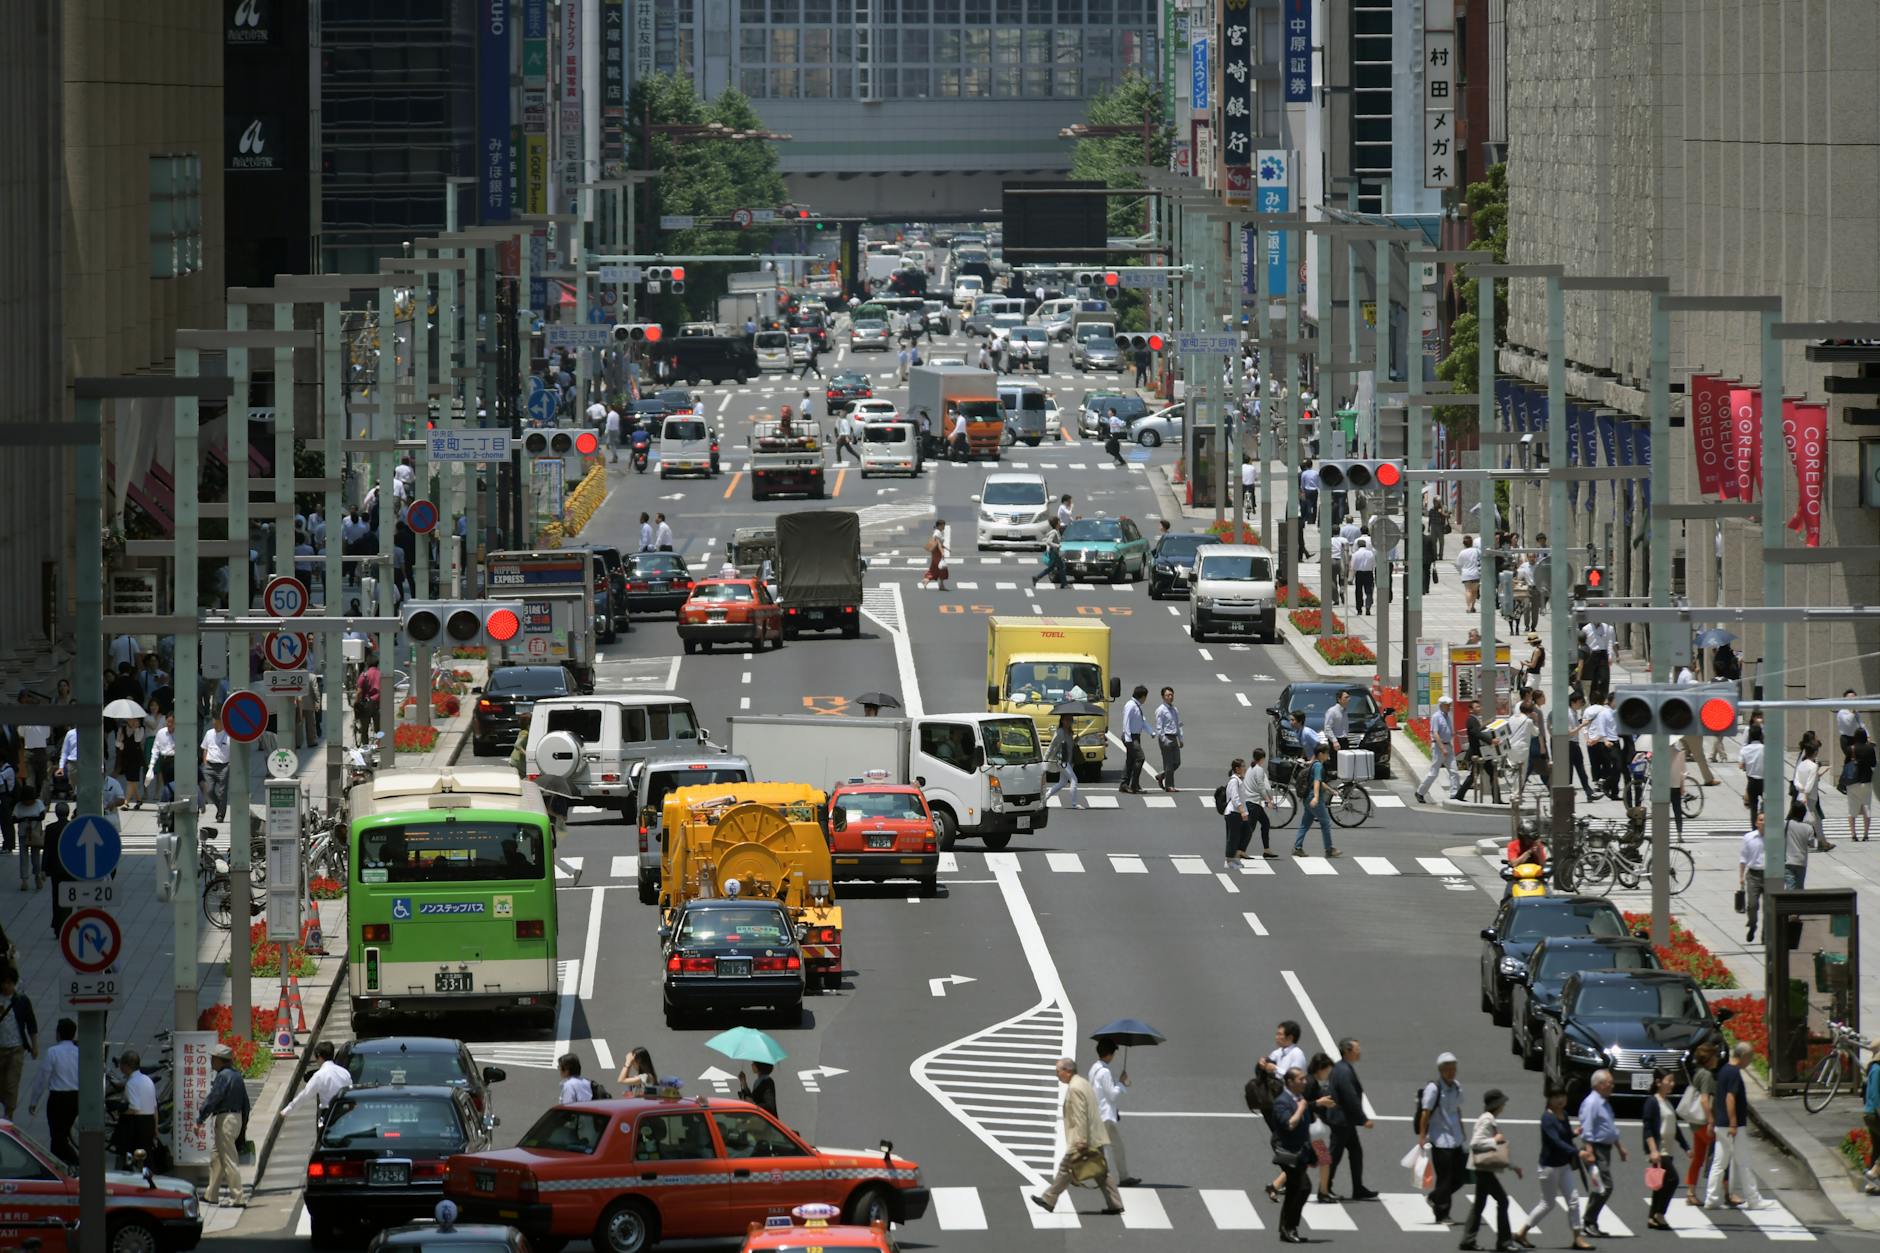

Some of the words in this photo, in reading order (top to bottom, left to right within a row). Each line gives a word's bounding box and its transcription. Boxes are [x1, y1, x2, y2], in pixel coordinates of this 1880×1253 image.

[566, 55, 577, 97] 証明写真
[607, 10, 621, 99] 大塚屋靴店
[1226, 25, 1249, 153] 宮崎銀行
[1290, 18, 1307, 95] 中原証券
[488, 137, 502, 207] みずほ銀行
[432, 438, 505, 452] 室町二丁目
[1698, 391, 1717, 465] COREDO
[1737, 405, 1753, 489] COREDO
[1804, 426, 1821, 515] COREDO
[274, 590, 298, 610] 50
[494, 566, 521, 574] NIPPON
[494, 575, 525, 583] EXPRESS
[420, 903, 485, 914] ノンステップバス
